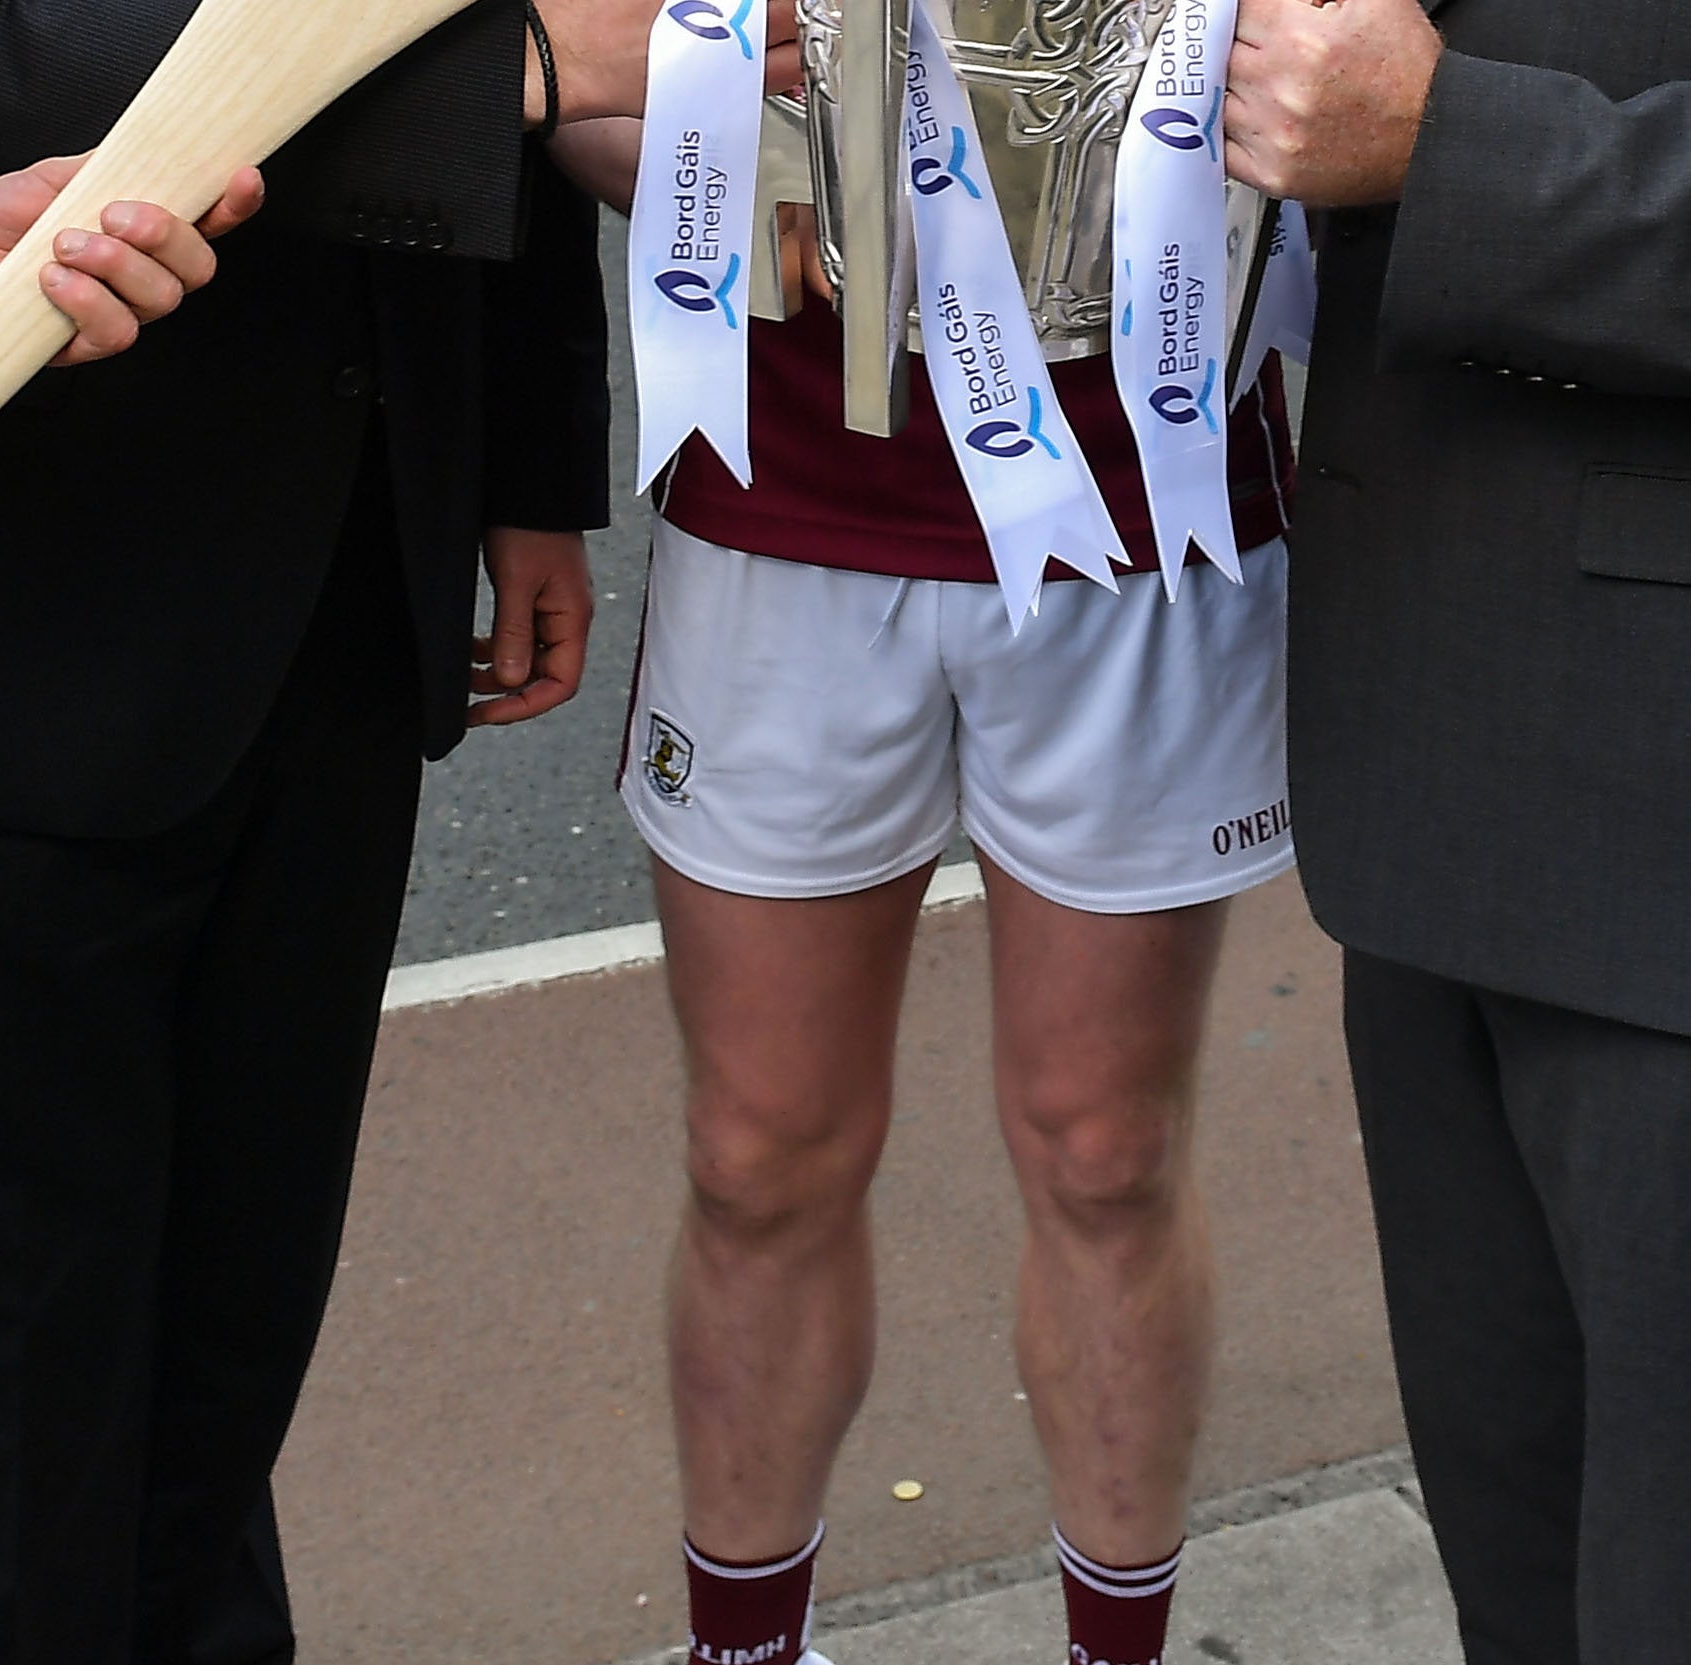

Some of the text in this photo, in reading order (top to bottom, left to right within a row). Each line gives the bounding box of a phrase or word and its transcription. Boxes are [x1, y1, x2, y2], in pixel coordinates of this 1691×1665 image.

[908, 50, 939, 143] Energy
[1156, 29, 1177, 96] Bord
[672, 131, 700, 260] Bord Gáis
[698, 167, 727, 261] Energy
[939, 283, 991, 416] Bord Gáis
[1159, 243, 1180, 375] Bord Gáis
[1180, 276, 1205, 373] Energy
[973, 312, 1016, 409] Energy
[1212, 799, 1291, 855] O'NEIL
